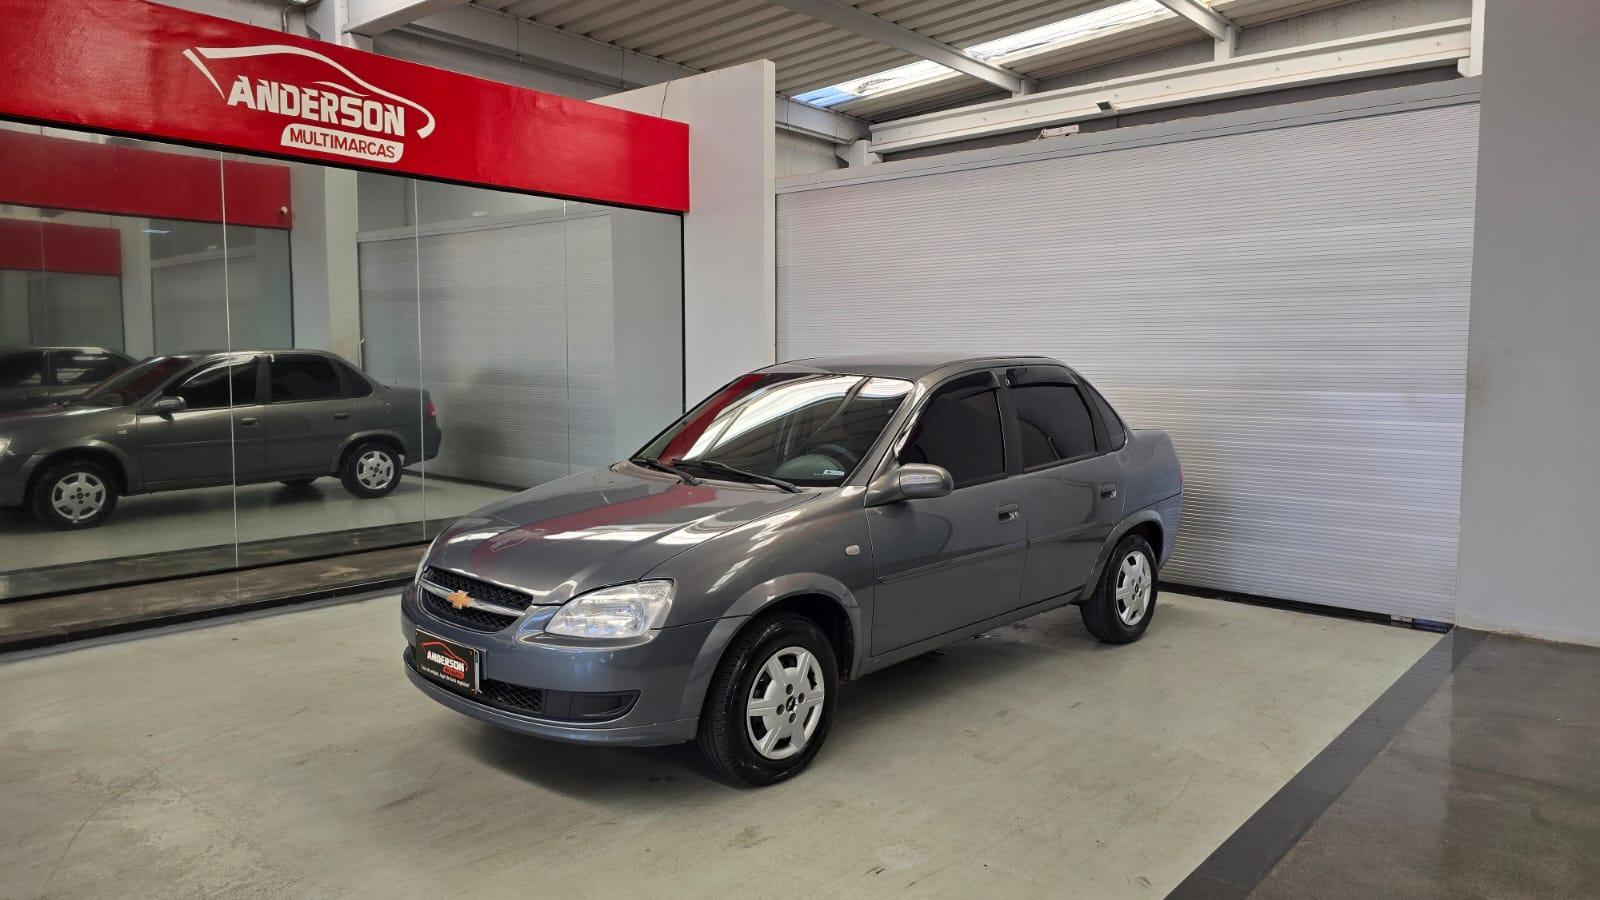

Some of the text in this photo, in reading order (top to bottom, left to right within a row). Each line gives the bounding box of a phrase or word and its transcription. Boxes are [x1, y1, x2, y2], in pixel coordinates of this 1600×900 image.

[226, 74, 405, 137] ANDERSON
[289, 127, 396, 159] MULTIMARCAS
[426, 650, 465, 672] ANDERSON
